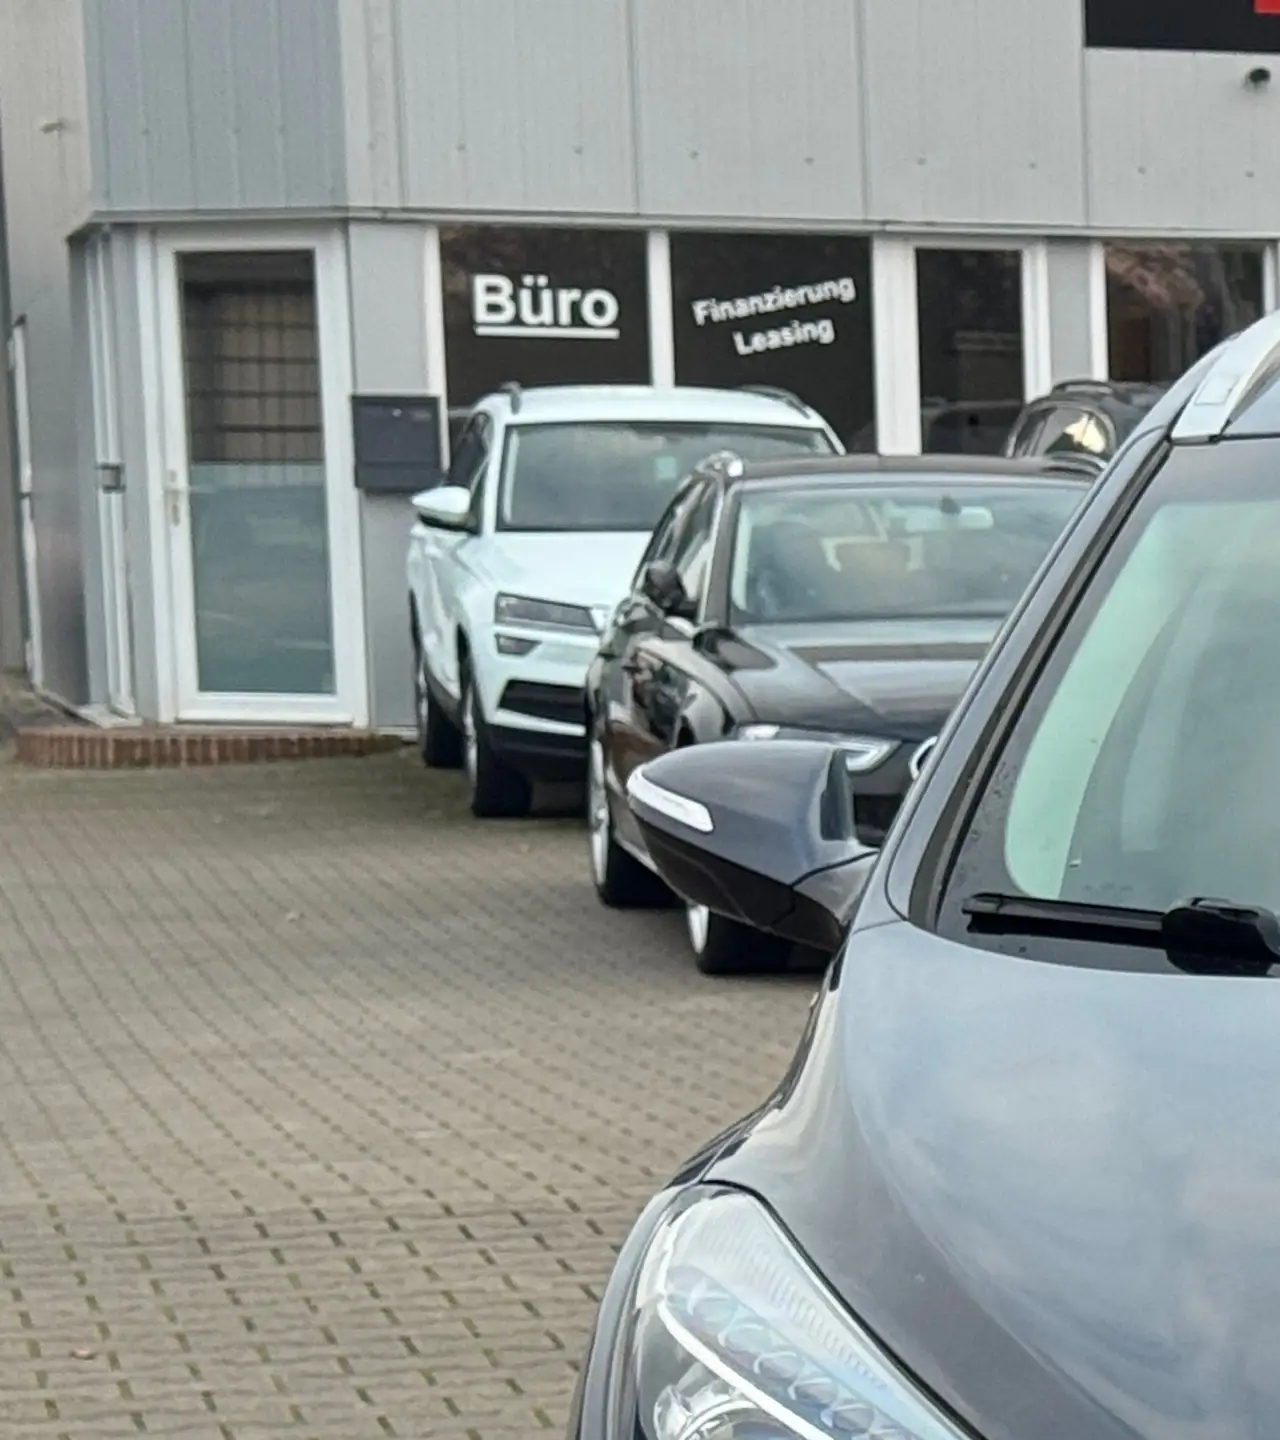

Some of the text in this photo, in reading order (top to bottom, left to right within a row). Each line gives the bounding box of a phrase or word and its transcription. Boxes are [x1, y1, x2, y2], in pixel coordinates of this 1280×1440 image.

[473, 274, 619, 327] Büro
[692, 277, 857, 326] Finanzierung
[733, 318, 836, 356] Leasing
